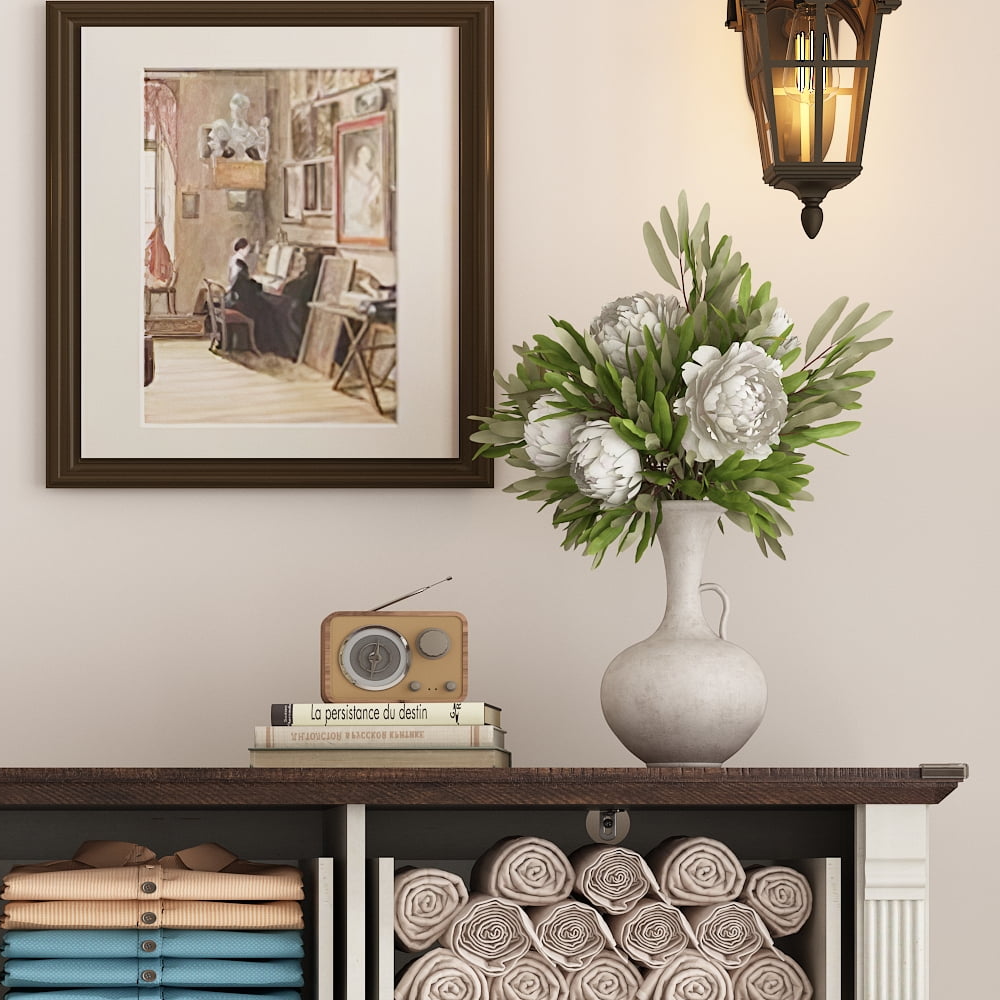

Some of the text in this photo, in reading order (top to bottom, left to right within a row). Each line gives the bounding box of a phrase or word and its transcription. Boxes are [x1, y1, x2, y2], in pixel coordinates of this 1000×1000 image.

[311, 704, 322, 720] La
[325, 704, 380, 726] persistance
[383, 704, 396, 720] du
[399, 704, 428, 720] destin
